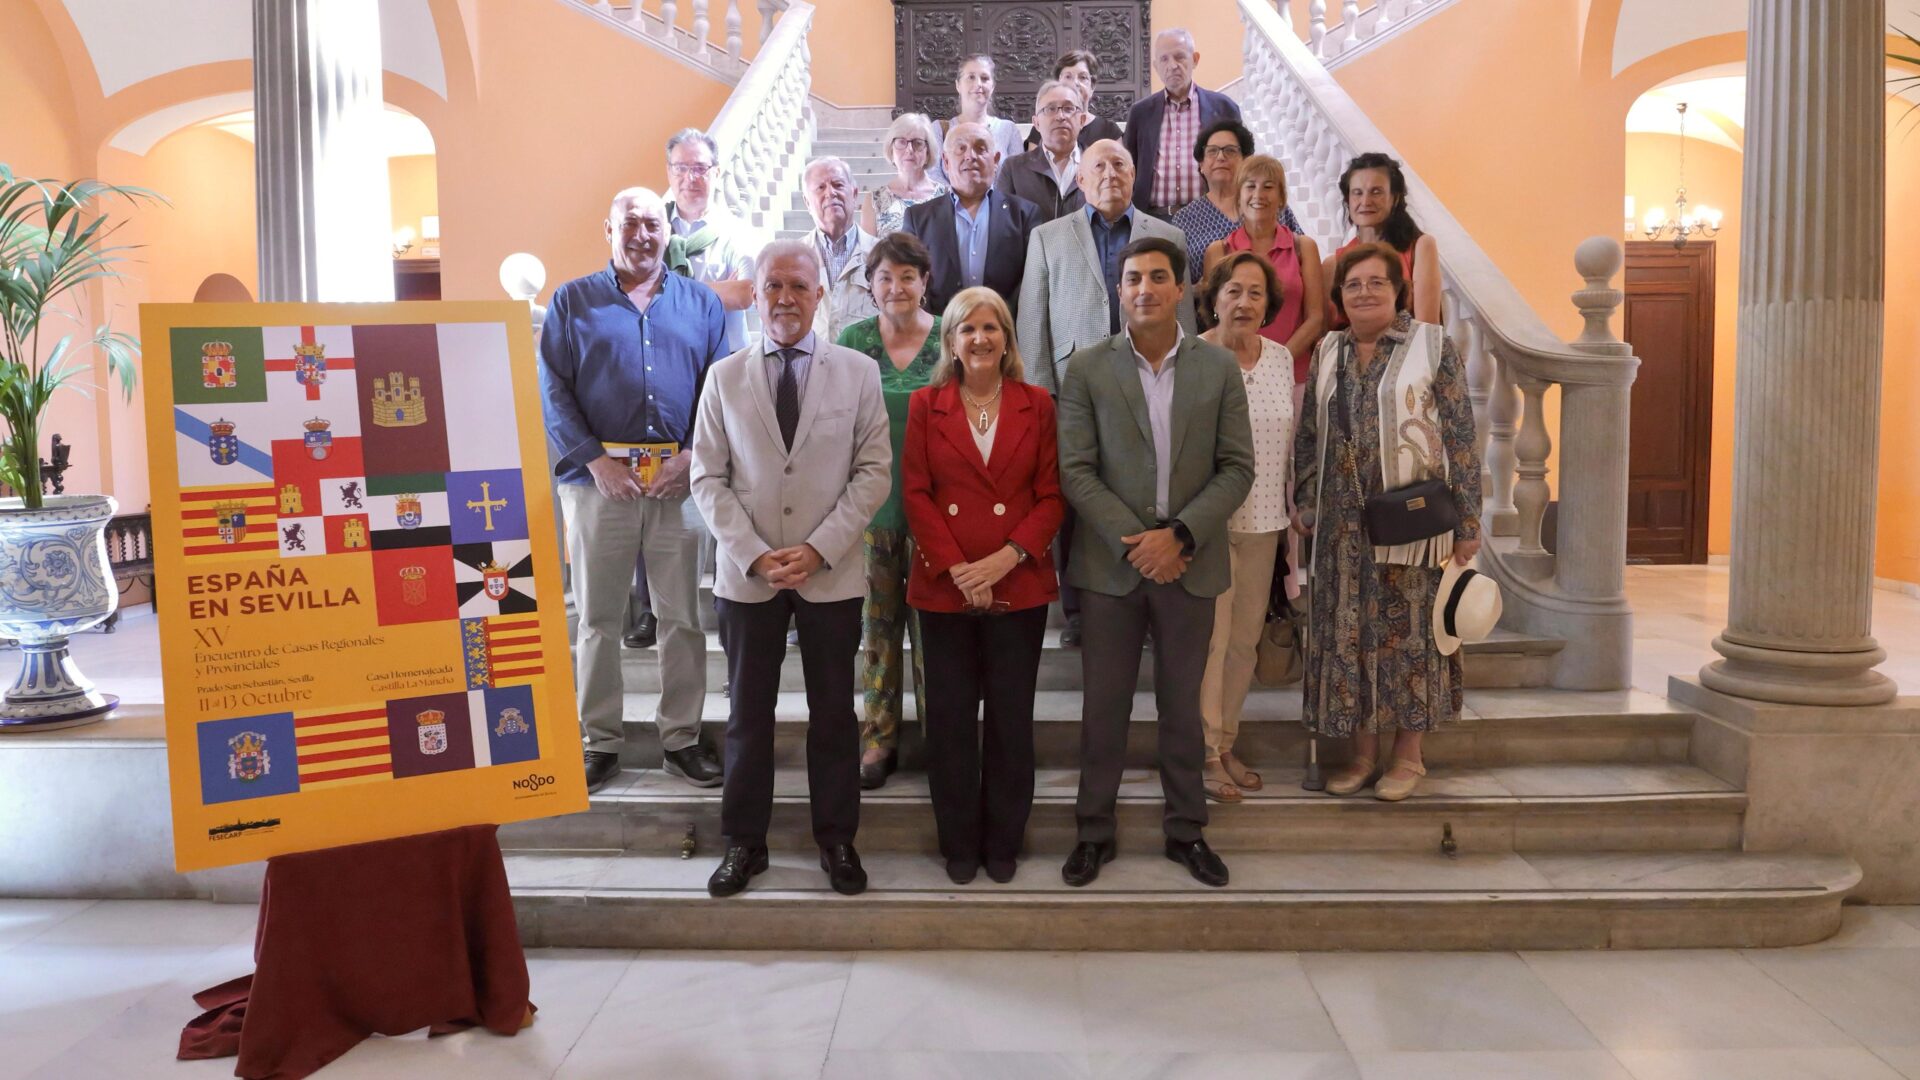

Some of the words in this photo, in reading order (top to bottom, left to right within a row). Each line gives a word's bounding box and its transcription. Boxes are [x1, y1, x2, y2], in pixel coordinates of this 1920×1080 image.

[188, 564, 308, 594] ESPAÑA
[189, 599, 228, 619] EN
[240, 588, 360, 614] SEVILLA
[194, 625, 230, 650] XV
[195, 648, 261, 663] Encuentro
[264, 645, 279, 656] de
[282, 642, 319, 655] Casas
[321, 635, 385, 652] Regionales
[195, 666, 203, 678] y
[206, 659, 280, 675] Provinciales
[366, 673, 389, 681] Casa
[391, 664, 453, 679] Homenajeada
[197, 684, 223, 694] Prado
[225, 683, 241, 691] San
[287, 674, 315, 684] Sevilla
[371, 681, 405, 692] Castilla
[407, 680, 418, 688] La
[420, 676, 455, 687] Mancha
[224, 694, 237, 711] 13
[242, 688, 313, 707] Octubre
